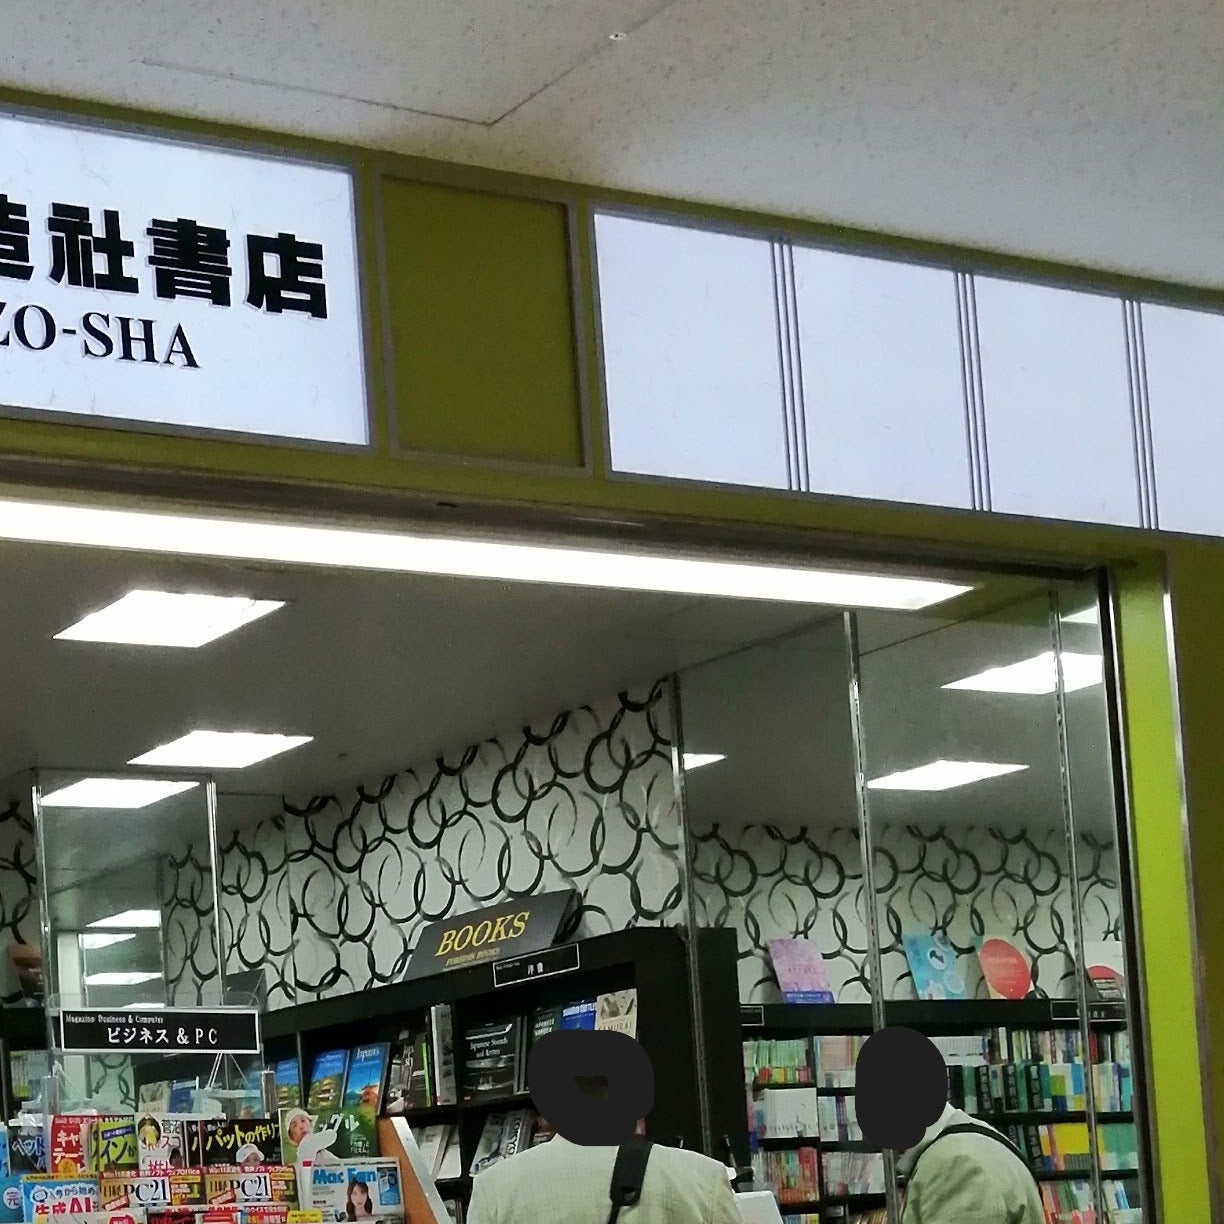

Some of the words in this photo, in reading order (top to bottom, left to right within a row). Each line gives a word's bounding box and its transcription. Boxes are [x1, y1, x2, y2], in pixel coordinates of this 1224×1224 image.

[435, 911, 530, 957] BOOKS
[312, 1168, 344, 1185] Mac
[347, 1167, 377, 1184] Fan
